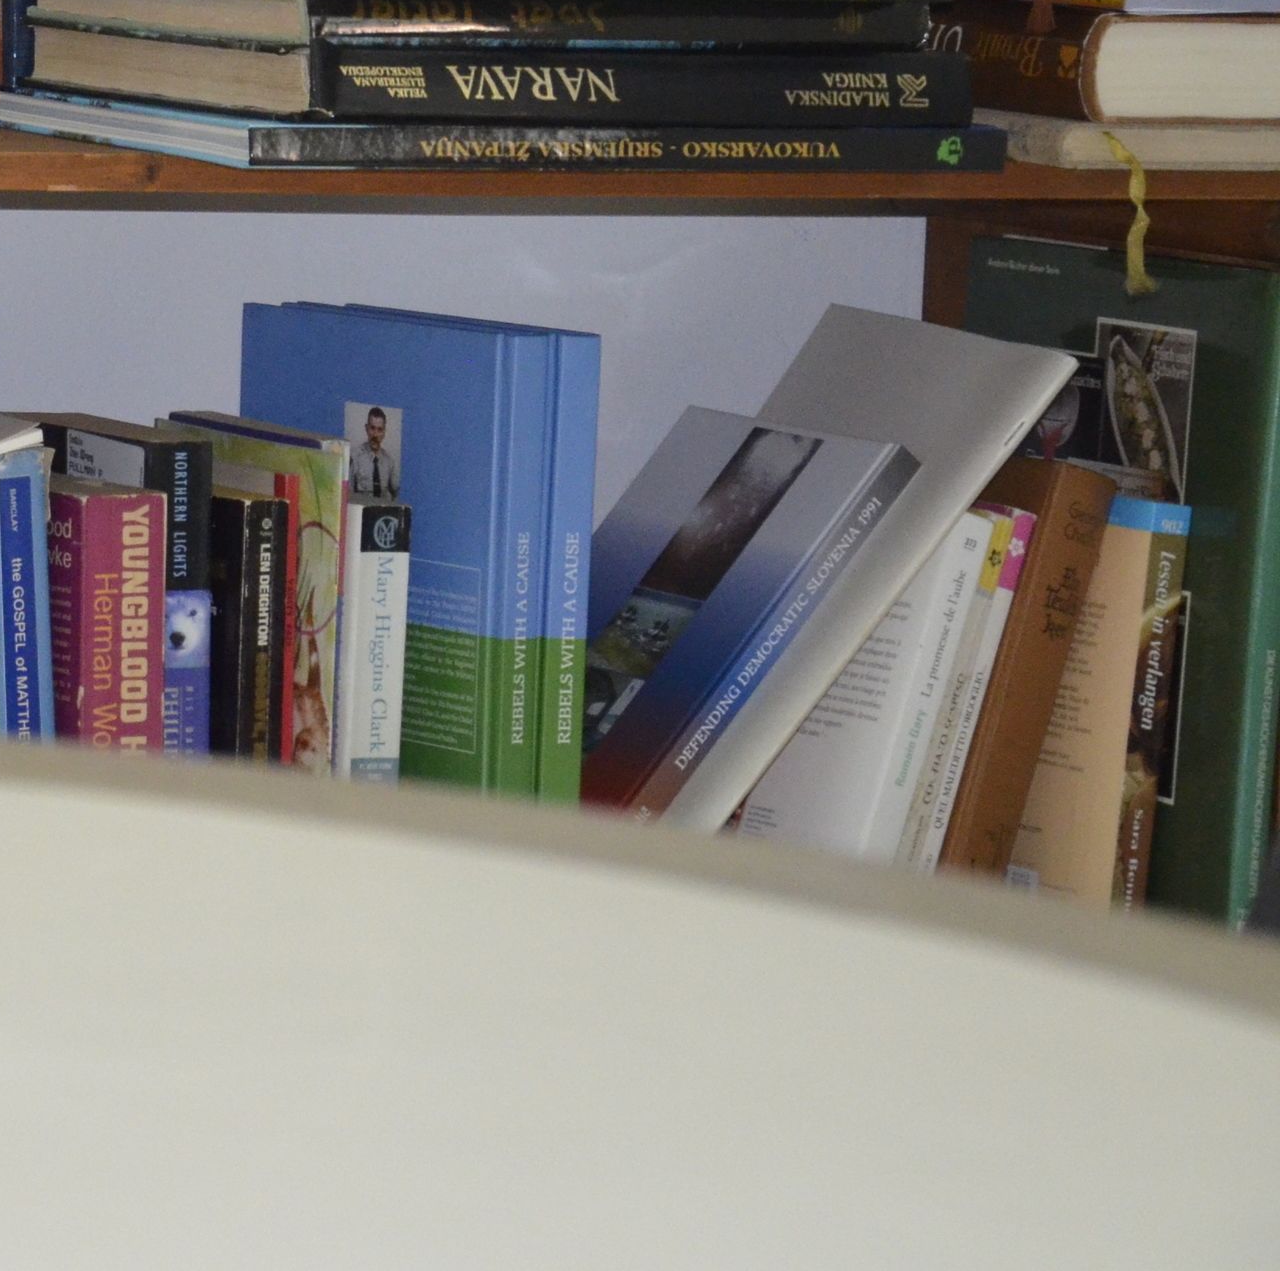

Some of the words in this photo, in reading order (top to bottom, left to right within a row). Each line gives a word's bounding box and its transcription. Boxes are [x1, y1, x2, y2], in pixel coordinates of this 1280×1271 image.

[340, 66, 423, 77] ENCIKLOPEDIJA
[353, 76, 426, 88] ILUSTRIRANA
[387, 87, 427, 99] VELIKA
[446, 65, 621, 102] NARAVA
[822, 71, 887, 89] KNJIGA
[784, 89, 890, 108] MLADINSKA
[419, 137, 530, 162] ŽUPANIJA
[537, 138, 663, 159] SRIJEMSKA
[682, 139, 841, 159] VUKOVARSKO
[9, 488, 19, 532] BARCLAY
[174, 451, 188, 523] NORTHERN
[12, 557, 24, 582] the
[173, 532, 187, 578] LIGHTS
[258, 544, 271, 572] LEN
[517, 531, 531, 594] CAUSE
[563, 531, 580, 594] CAUSE
[371, 556, 393, 607] Mary
[1157, 550, 1177, 608] Lessen
[13, 586, 27, 652] GOSPEL
[121, 505, 150, 722] YOUNGBLOOD
[257, 575, 270, 646] DEIGHTON
[517, 600, 529, 614] A
[563, 600, 577, 614] A
[945, 608, 955, 624] de
[1152, 612, 1170, 633] in
[93, 572, 118, 691] Herman
[369, 614, 392, 691] Higgins
[515, 621, 528, 672] WITH
[560, 621, 575, 672] WITH
[674, 686, 740, 770] DEFENDING
[738, 595, 809, 692] DEMOCRATIC
[806, 529, 862, 603] SLOVENIA
[857, 497, 883, 534] 1991
[926, 628, 950, 680] promesse
[15, 656, 28, 671] of
[1139, 640, 1165, 731] verlangen
[511, 674, 527, 746] REBELS
[557, 674, 573, 746] REBELS
[922, 682, 933, 697] La
[369, 698, 388, 753] Clark
